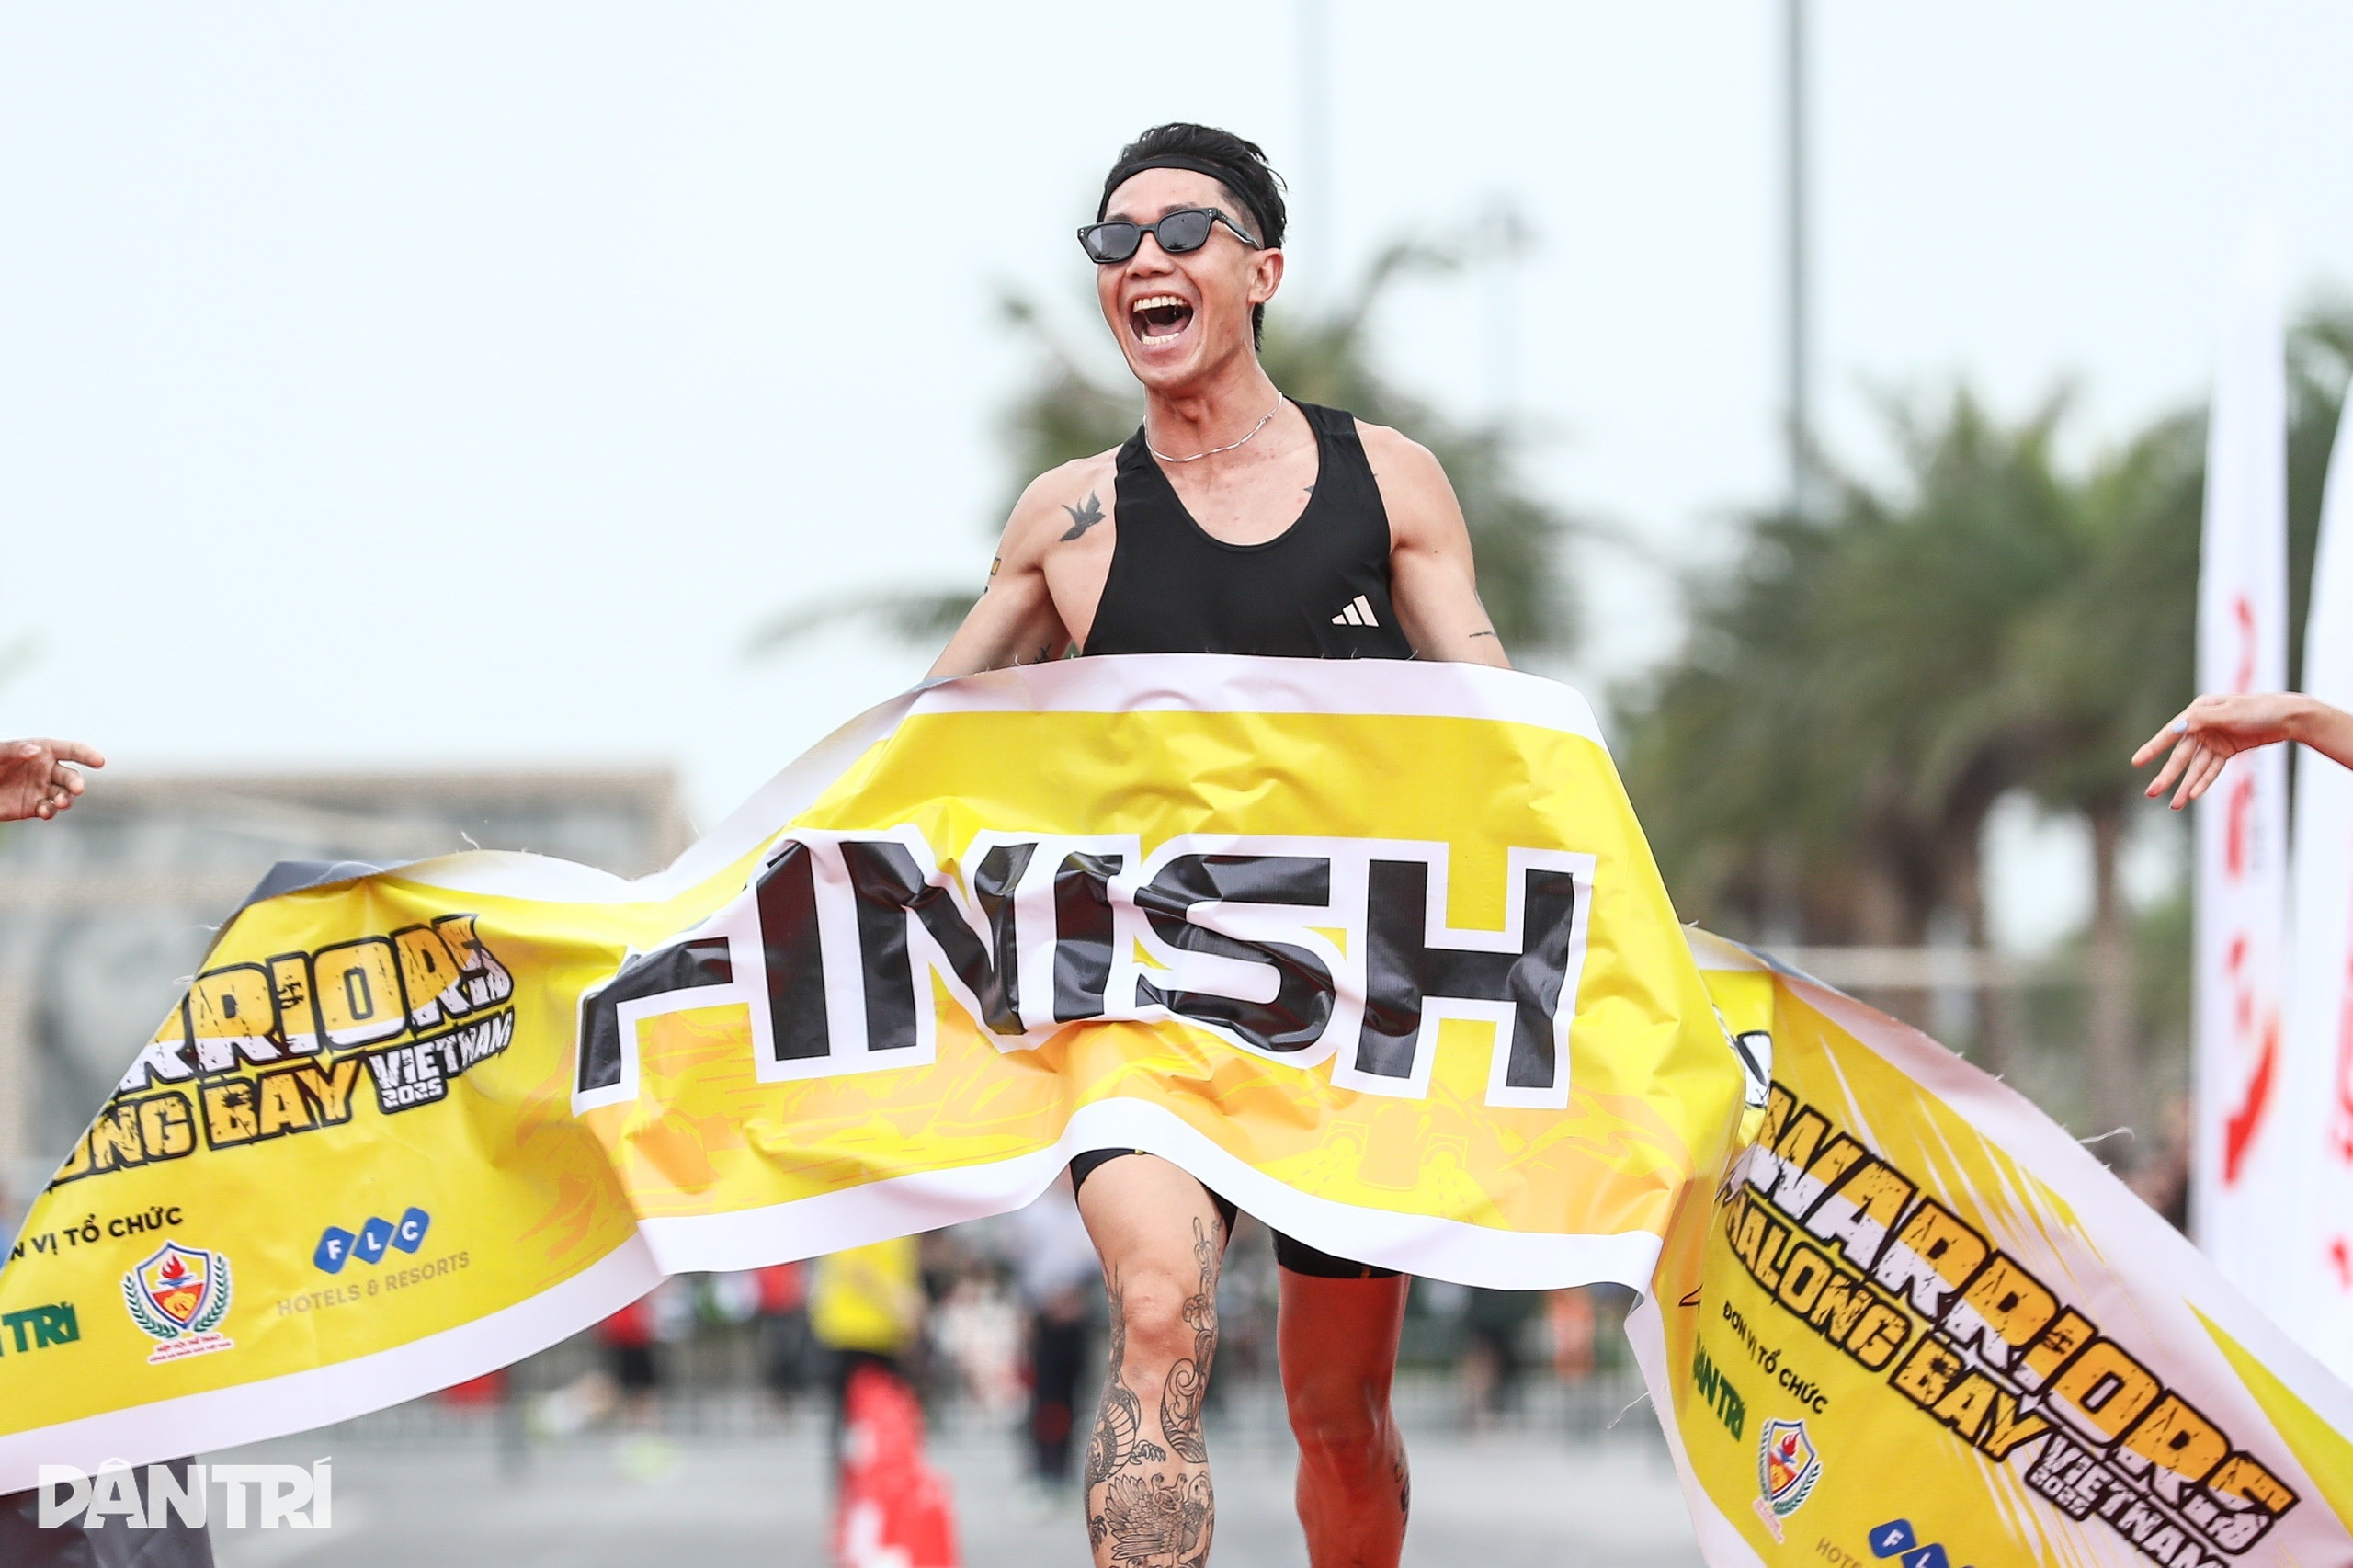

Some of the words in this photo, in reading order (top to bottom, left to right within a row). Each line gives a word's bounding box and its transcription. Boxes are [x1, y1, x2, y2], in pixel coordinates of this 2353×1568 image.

[367, 1007, 515, 1091] VIETNAM
[197, 1052, 366, 1151] BAY
[380, 1078, 444, 1108] 2025
[31, 1232, 59, 1256] VỊ
[63, 1213, 101, 1246] TỔ
[108, 1205, 184, 1238] CHỨC
[323, 1216, 422, 1264] FLC
[277, 1283, 361, 1317] HOTELS
[385, 1250, 471, 1291] RESORTS
[1740, 1079, 2301, 1555] WARRIORS
[1779, 1368, 1829, 1415] CHỨC
[1888, 1331, 2054, 1462] BAY
